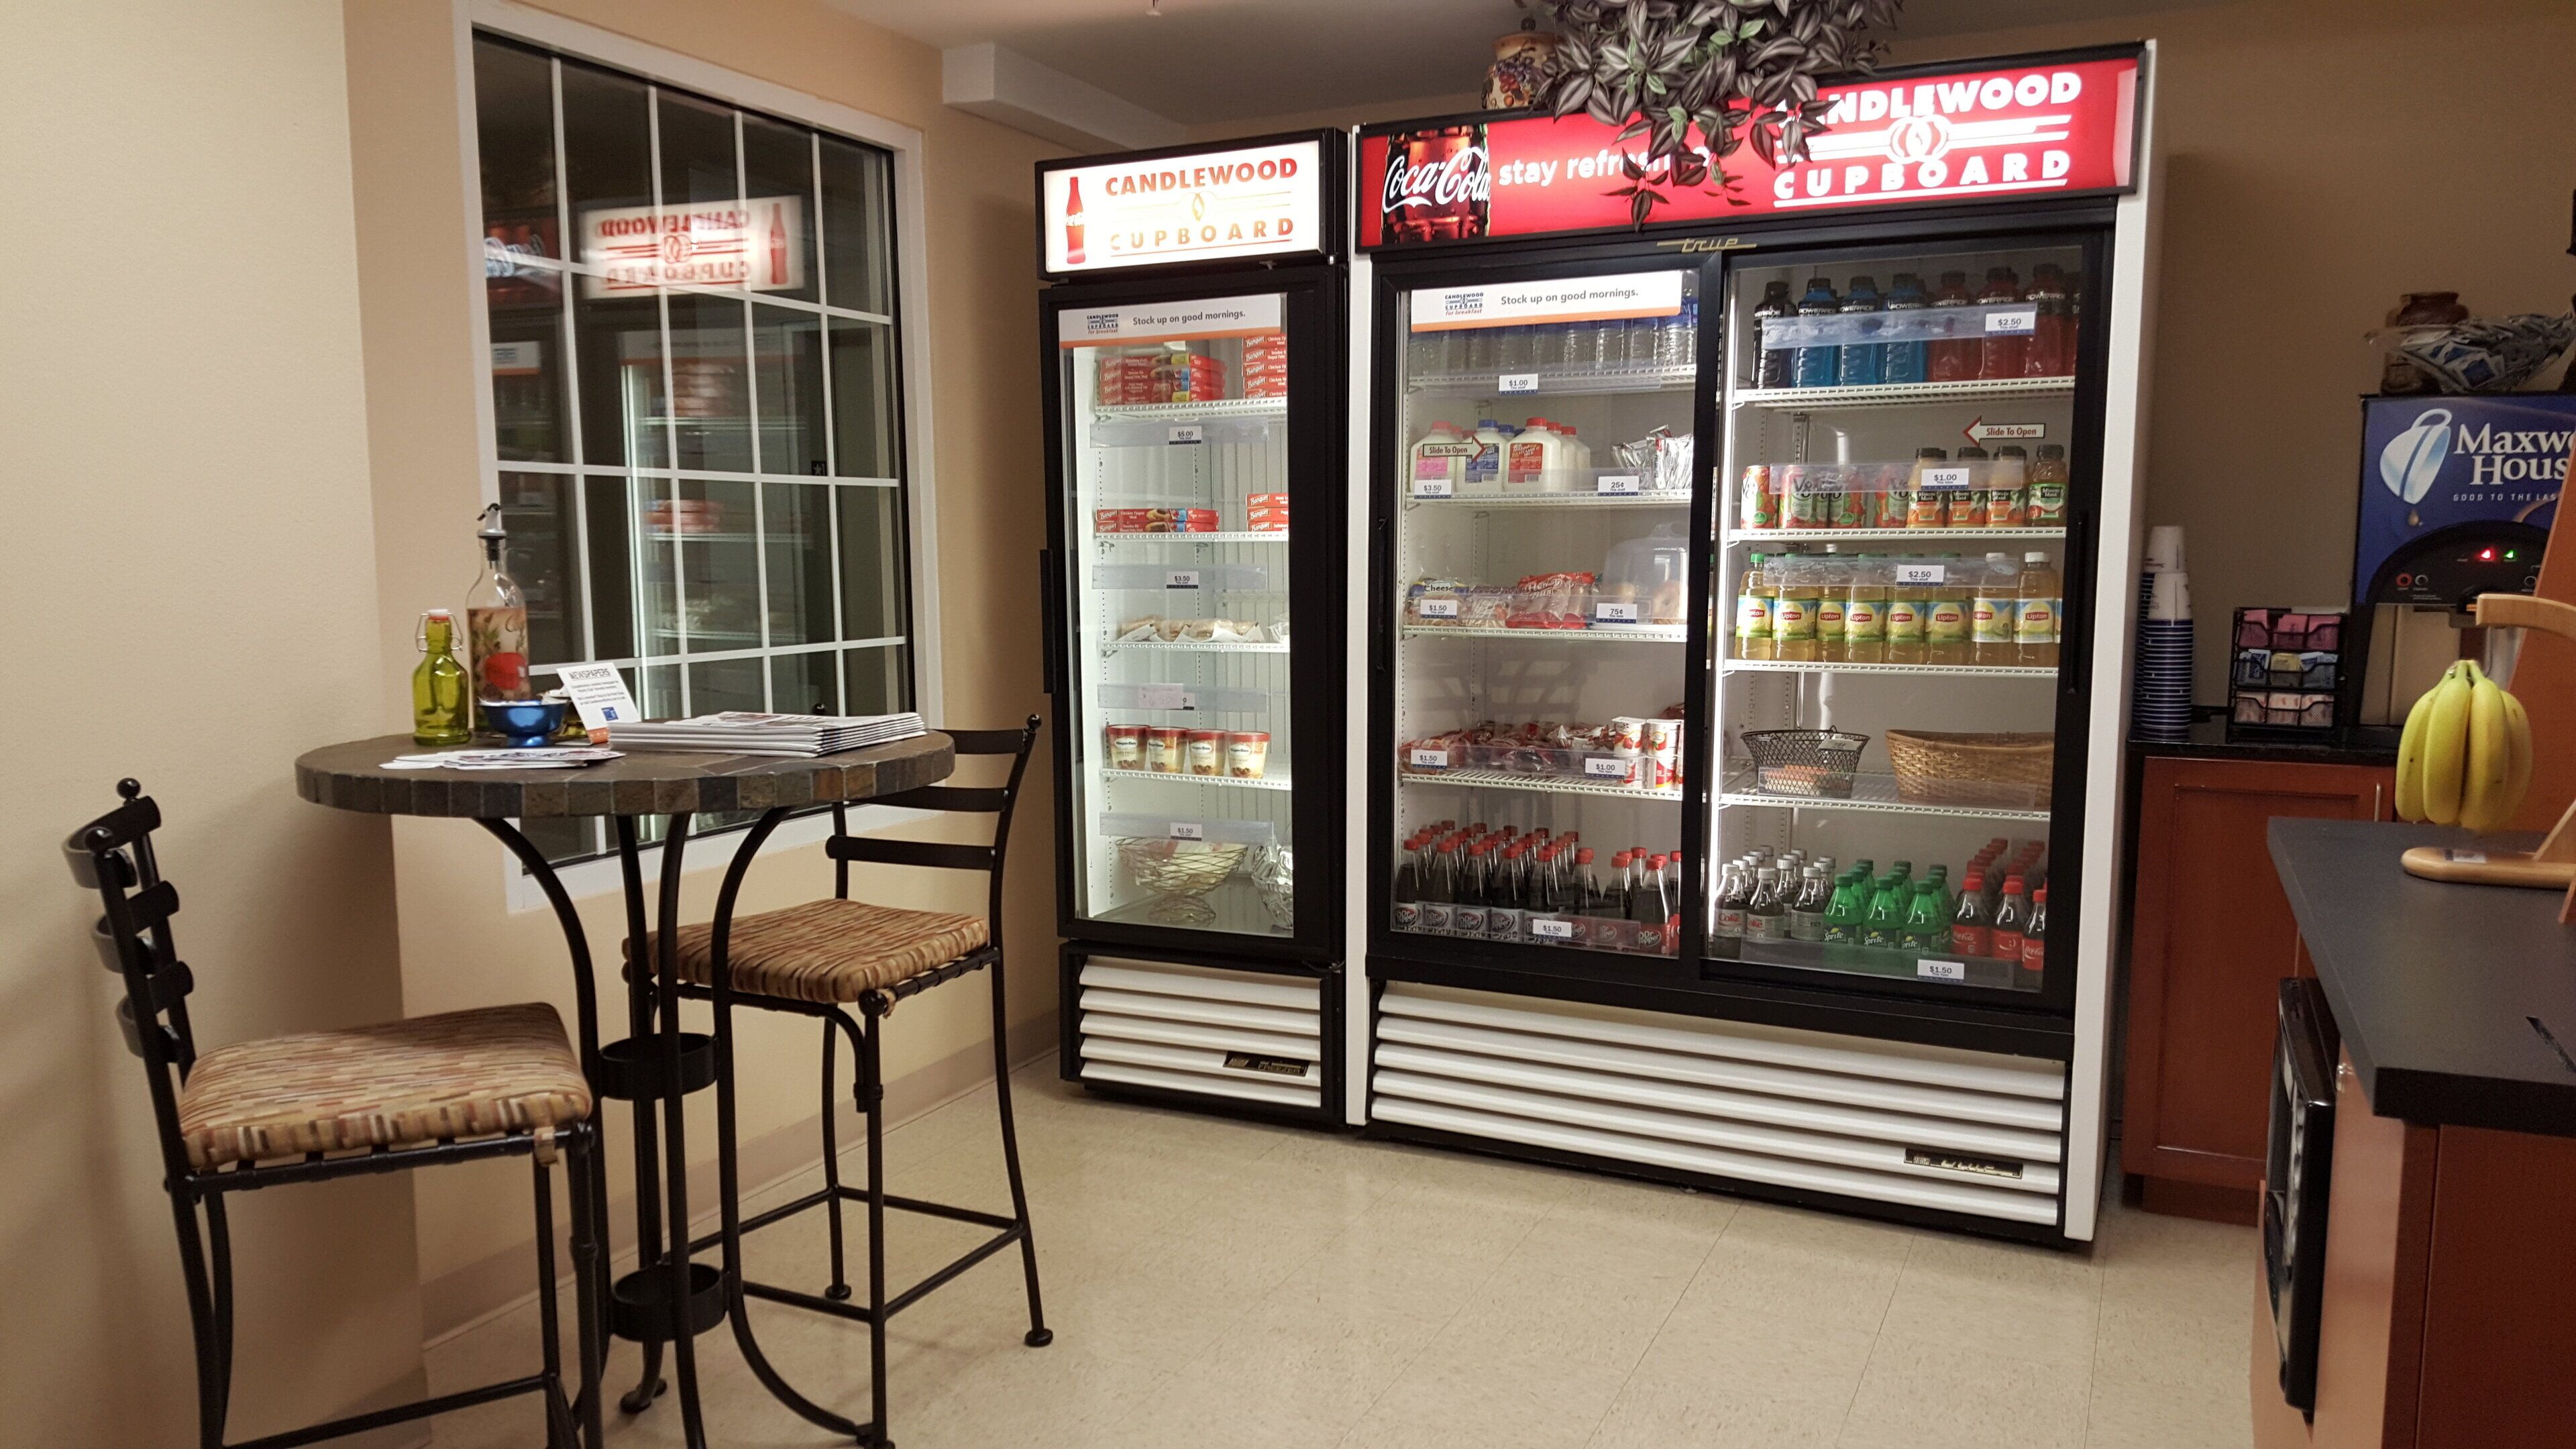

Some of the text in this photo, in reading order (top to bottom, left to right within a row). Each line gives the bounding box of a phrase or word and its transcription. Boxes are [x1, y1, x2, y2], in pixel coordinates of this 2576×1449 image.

[1776, 71, 2082, 129] NDLEWOOD
[1106, 157, 1298, 197] CANDLEWOOD
[1498, 159, 1558, 186] stay
[1773, 150, 2071, 199] CUPBOARD
[1382, 146, 1491, 213] Coca-Cola
[1110, 217, 1294, 251] CUPBOARD
[1444, 292, 1484, 300] CANDLEWOOD
[1501, 295, 1527, 305] Stock
[1530, 295, 1542, 305] up
[1561, 290, 1587, 303] good
[1589, 288, 1639, 300] mornings.
[1133, 315, 1155, 325] Stock
[1157, 316, 1167, 325] up
[1182, 312, 1203, 323] good
[1205, 310, 1246, 320] mornings.
[1754, 309, 1781, 317] WERADE
[1998, 318, 2021, 326] $2.50
[1986, 427, 2004, 435] Slide
[2017, 427, 2037, 437] Open
[2454, 423, 2575, 454] Maxw
[2469, 455, 2569, 485] Hous
[2536, 493, 2557, 501] LAS
[1750, 610, 1764, 618] pton
[1781, 612, 1801, 621] Lipton
[1821, 612, 1839, 621] Lipton
[1851, 614, 1870, 622] Lipton
[2027, 612, 2047, 620] Lipton
[569, 668, 611, 680] NEWSPAPERS
[1719, 913, 1740, 923] Coke
[1748, 919, 1763, 928] oke
[1823, 932, 1844, 943] Sprite
[1864, 935, 1884, 946] Sprite
[1929, 965, 1952, 974] $1.50
